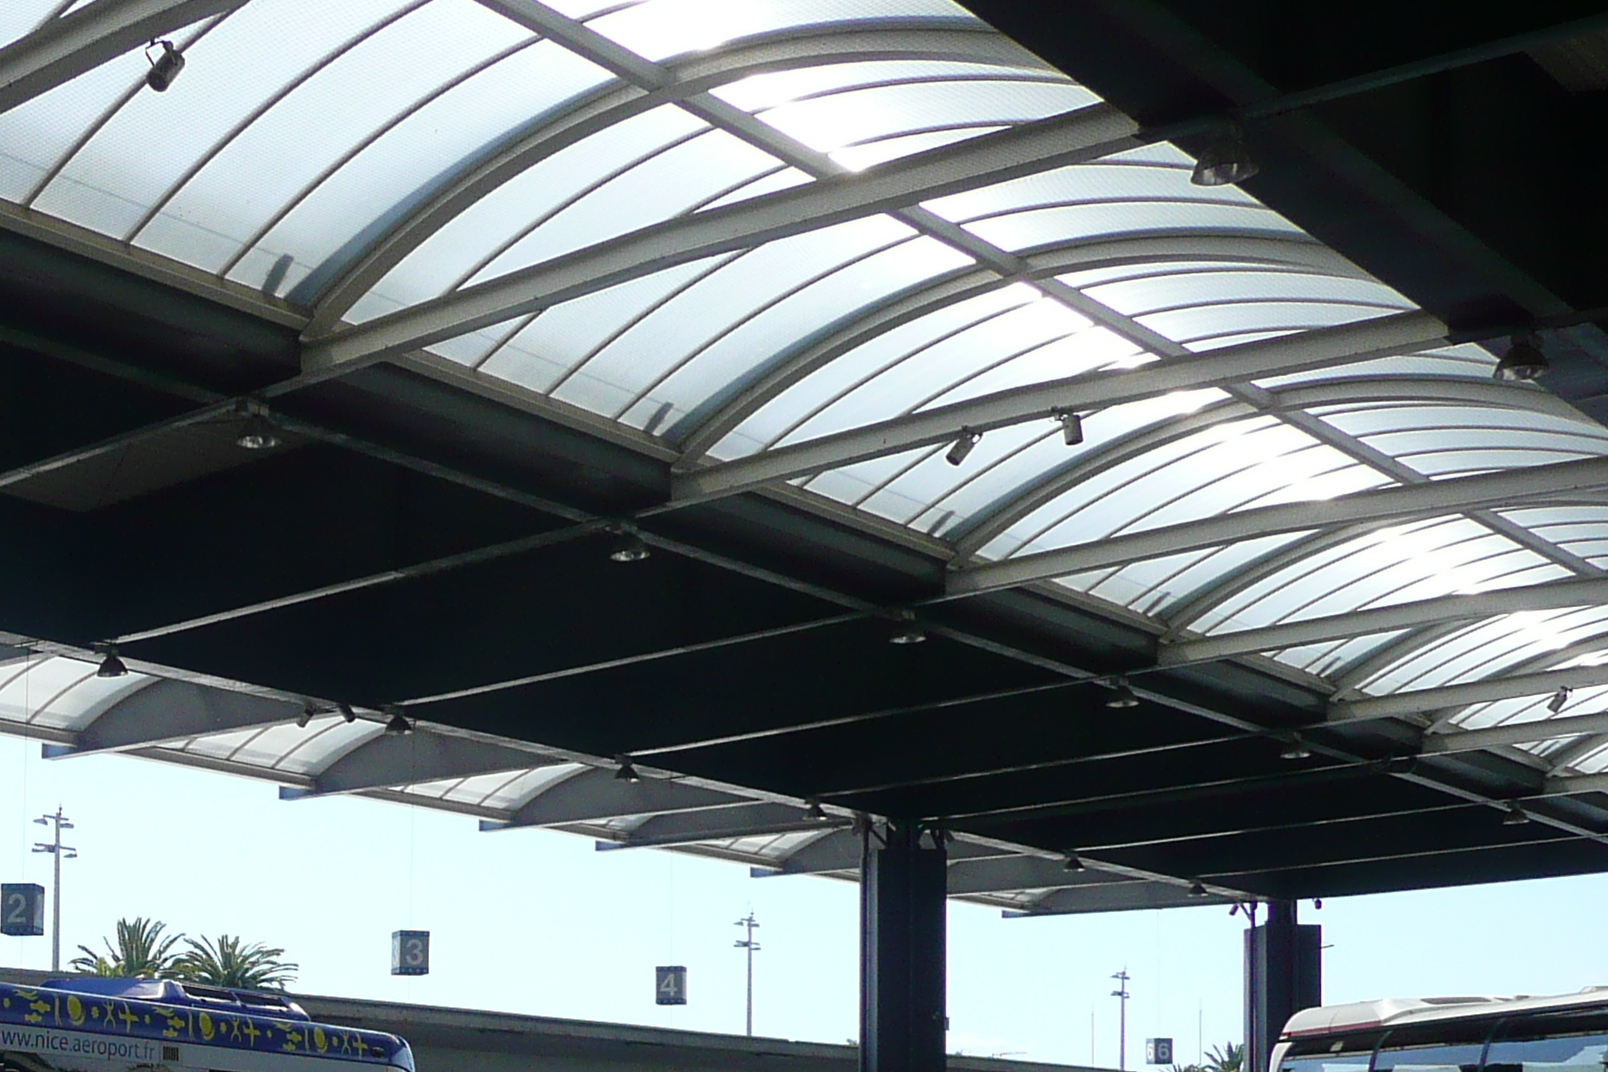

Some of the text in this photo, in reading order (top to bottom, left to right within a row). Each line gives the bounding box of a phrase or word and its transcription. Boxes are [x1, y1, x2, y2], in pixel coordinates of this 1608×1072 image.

[7, 893, 27, 923] 2
[405, 939, 423, 965] 3
[660, 973, 678, 996] 4
[1158, 1043, 1169, 1060] 6
